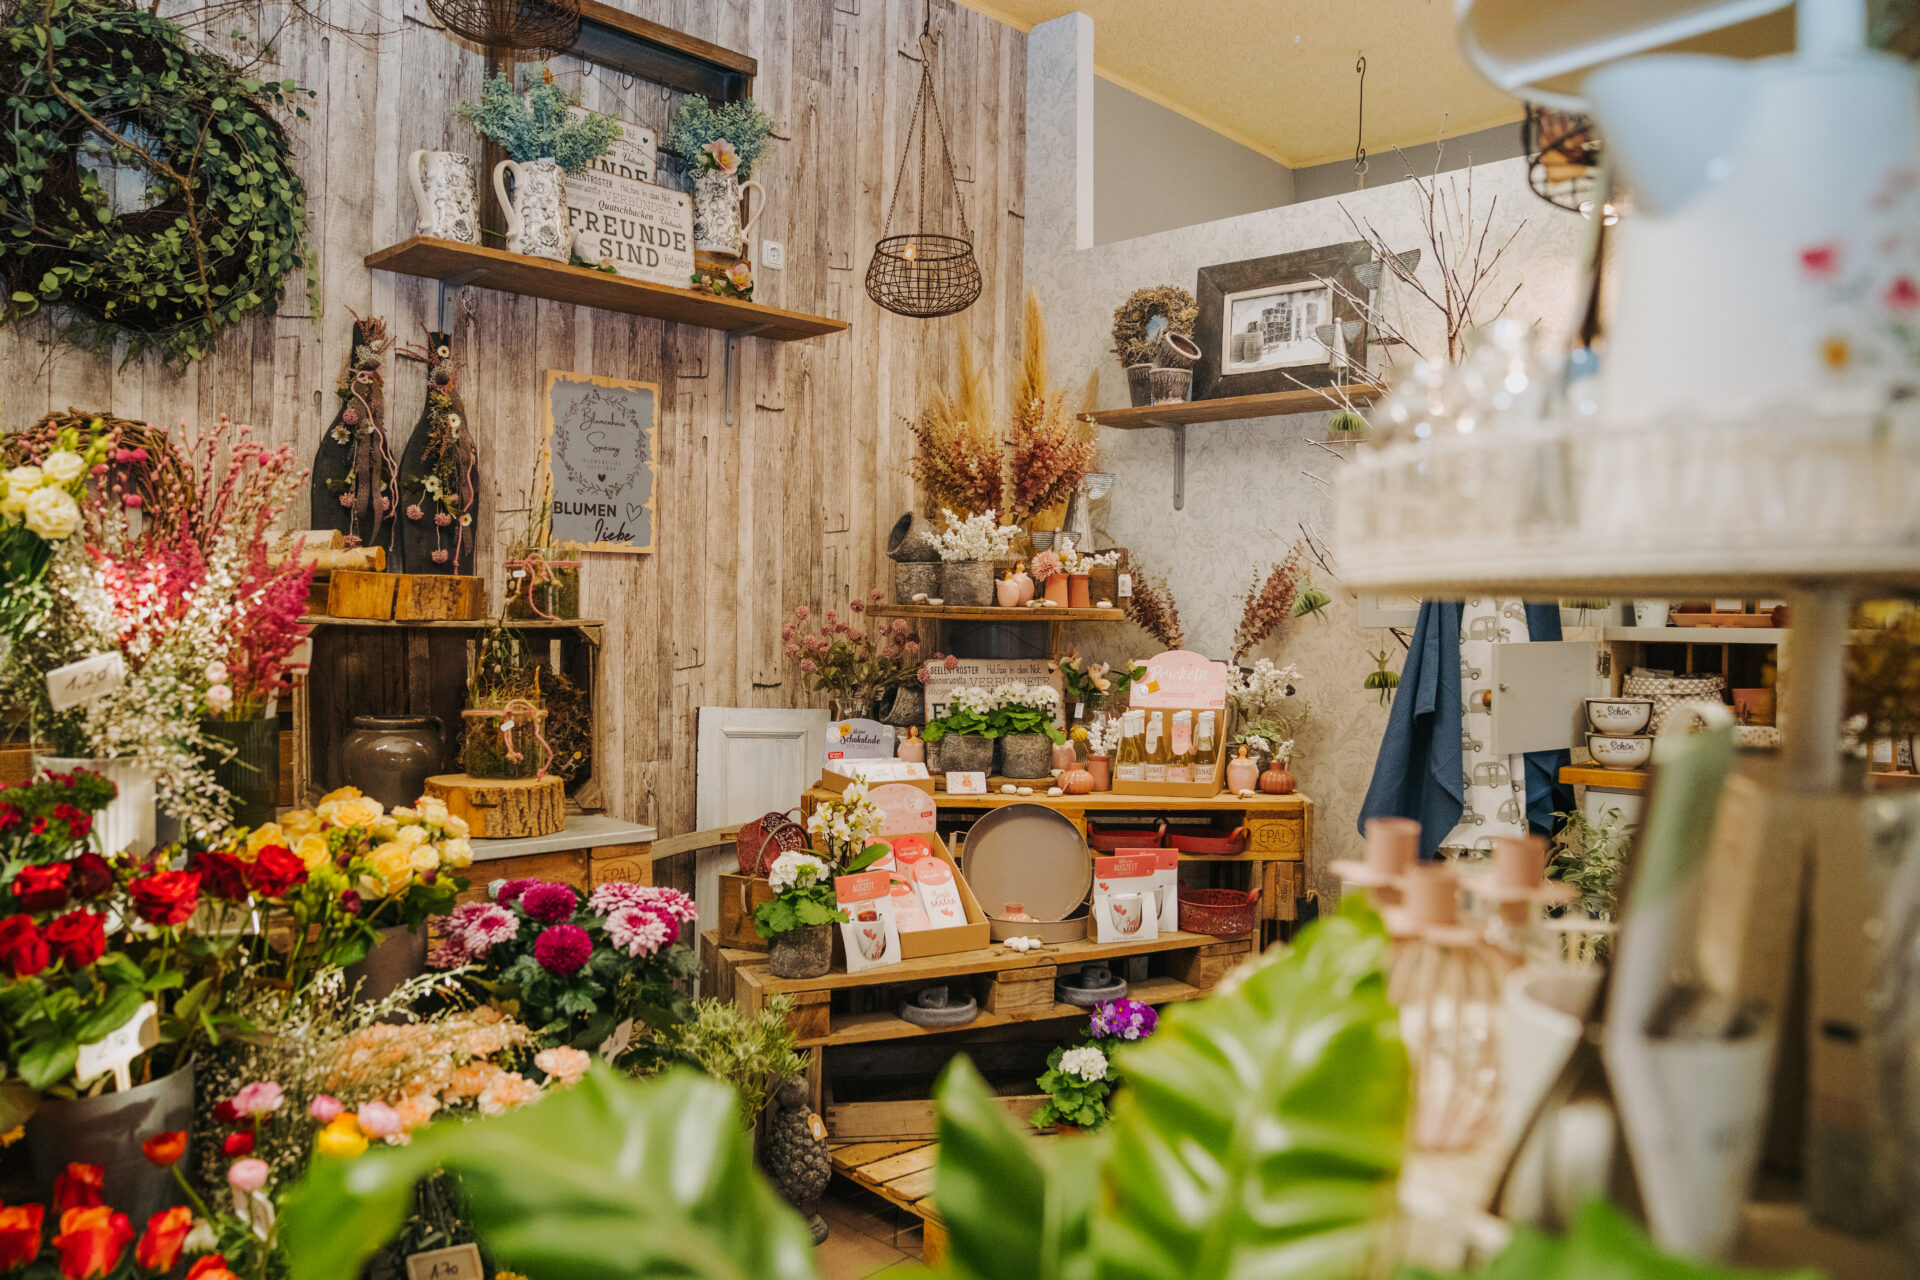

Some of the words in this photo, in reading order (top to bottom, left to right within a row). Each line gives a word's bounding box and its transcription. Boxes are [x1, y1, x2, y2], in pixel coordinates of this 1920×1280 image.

[598, 200, 654, 221] Quatschbacken
[568, 206, 687, 252] FREUNDE
[599, 238, 660, 268] SIND
[553, 500, 617, 517] BLUMEN
[1259, 829, 1288, 844] EPAL
